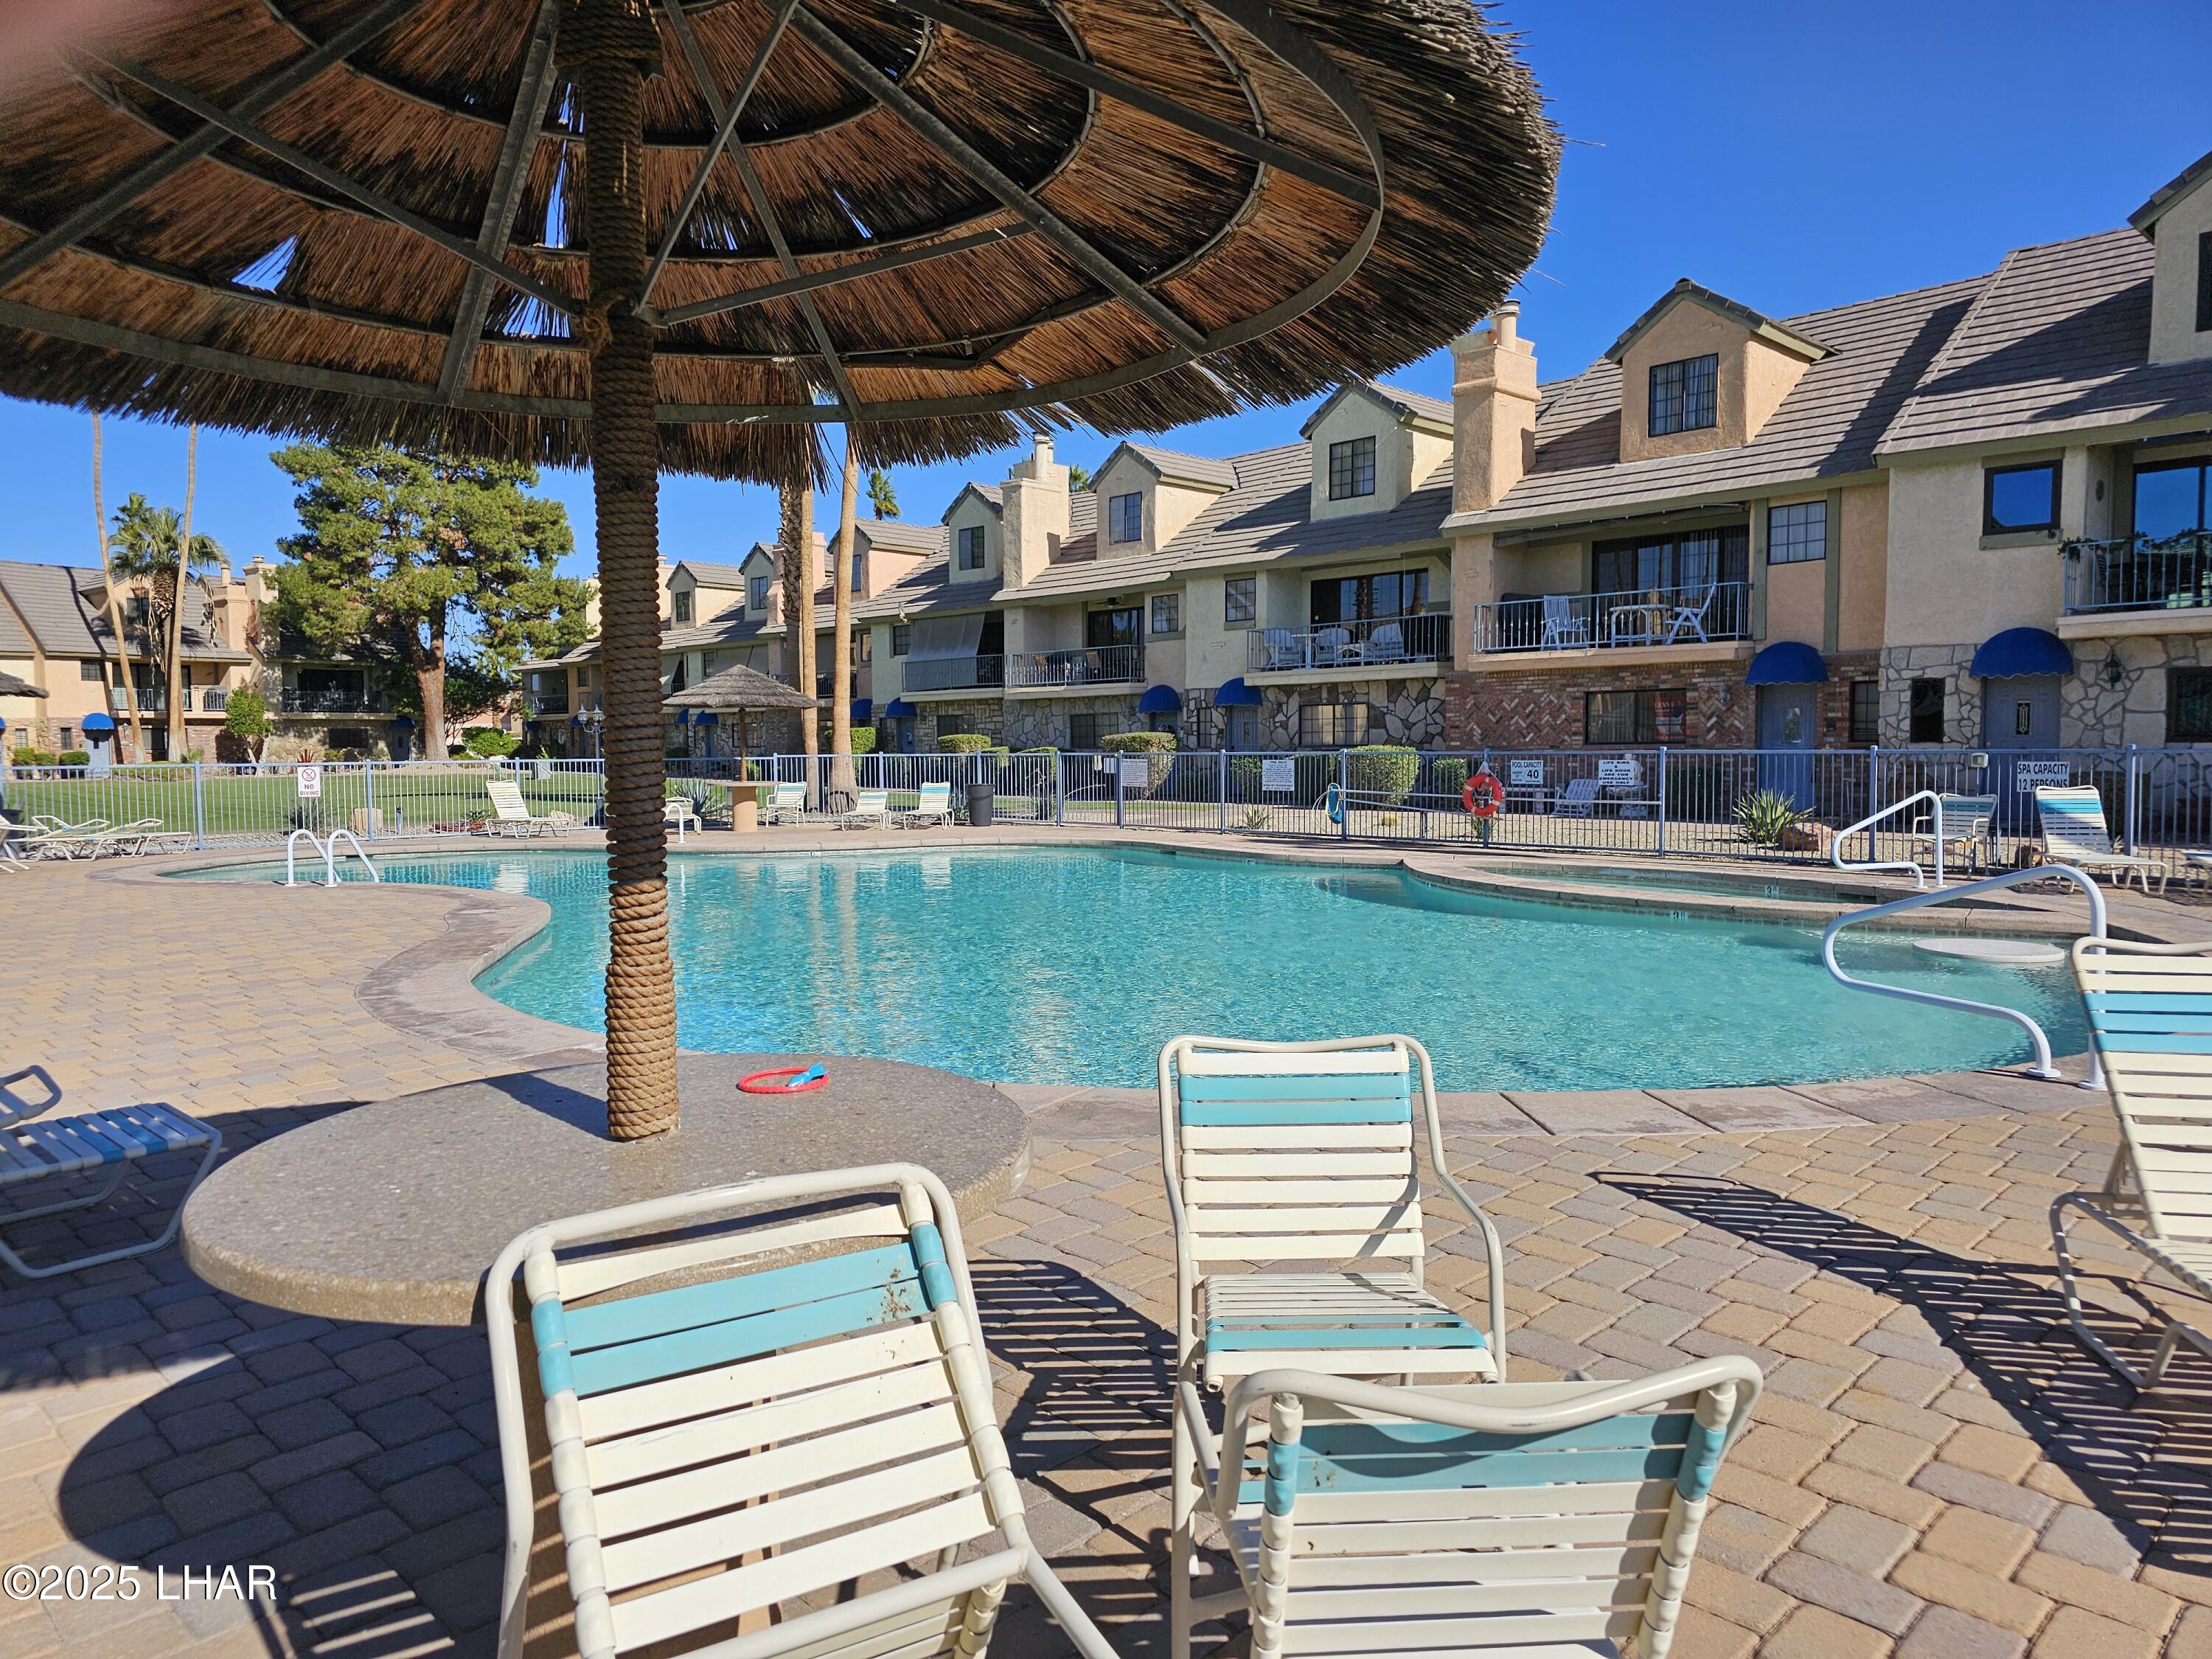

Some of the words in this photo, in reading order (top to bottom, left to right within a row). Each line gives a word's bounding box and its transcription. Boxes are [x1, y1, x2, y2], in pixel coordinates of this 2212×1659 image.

[1527, 769, 1539, 779] 40
[2018, 763, 2031, 774] SPA
[2034, 763, 2068, 774] CAPACITY
[2019, 779, 2028, 790] 12
[2030, 779, 2067, 789] PERSONS
